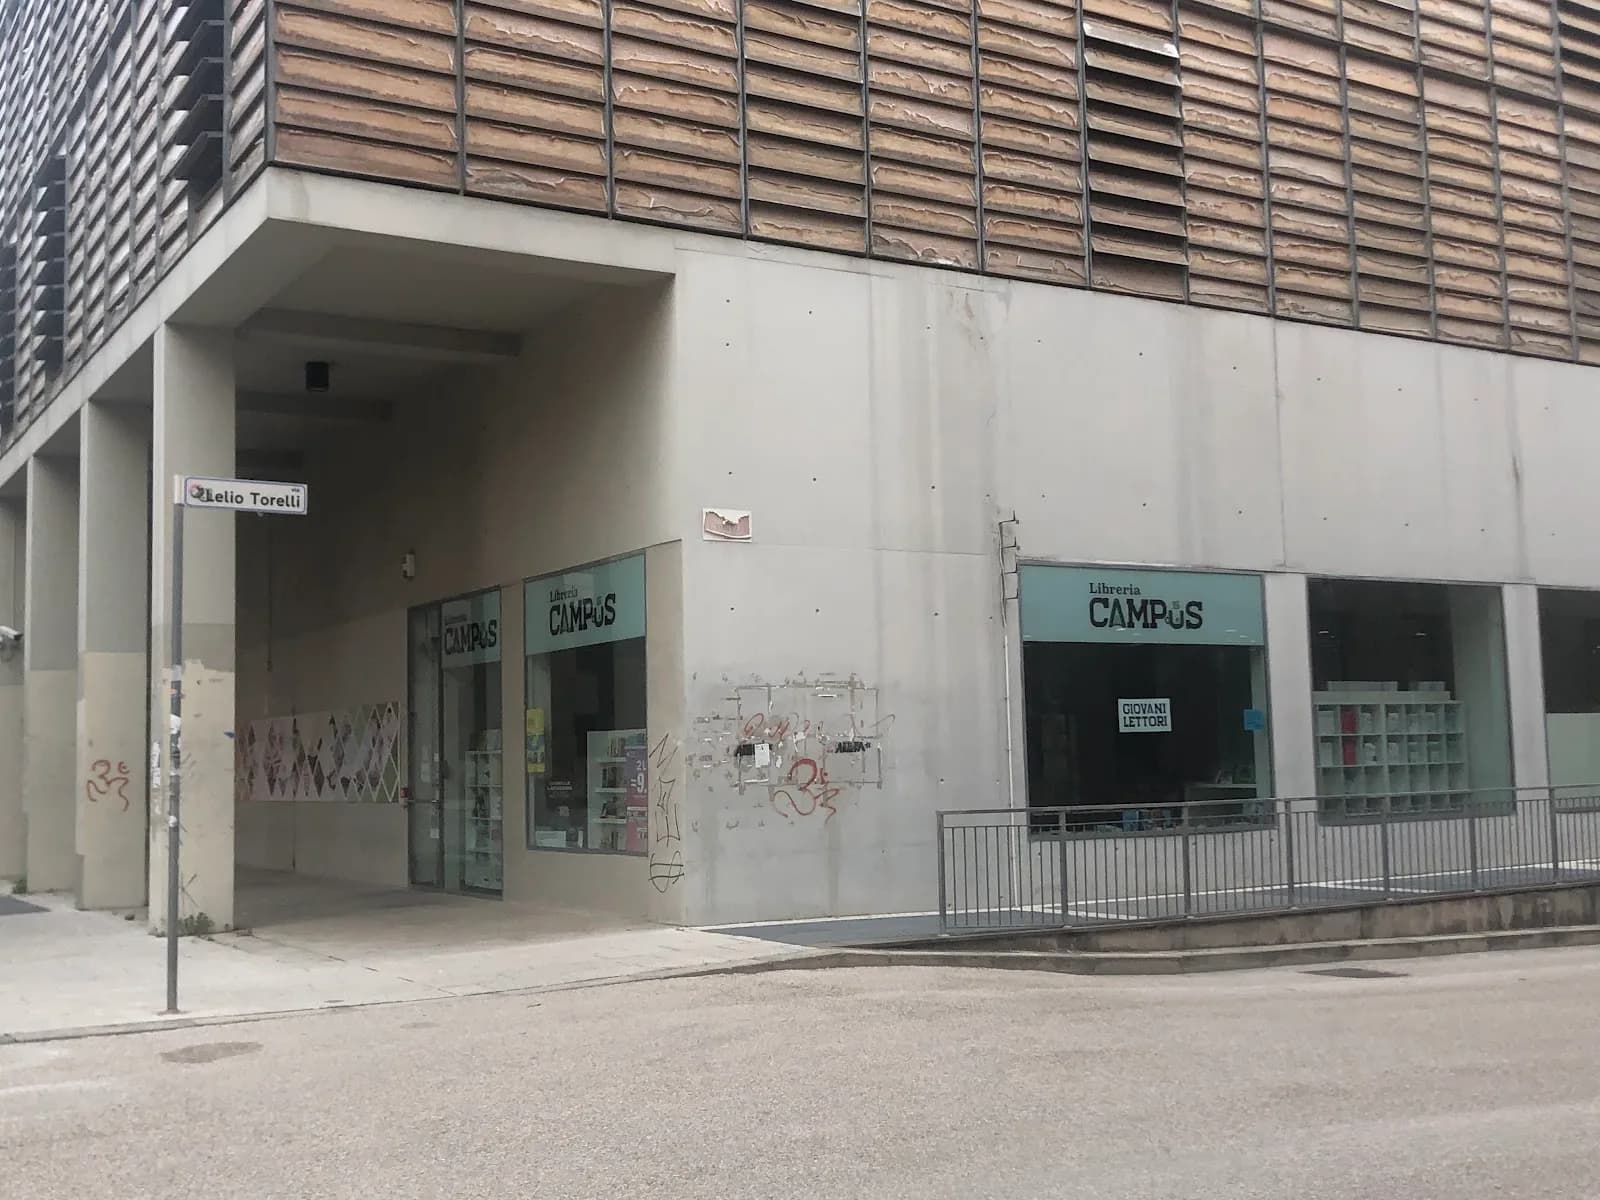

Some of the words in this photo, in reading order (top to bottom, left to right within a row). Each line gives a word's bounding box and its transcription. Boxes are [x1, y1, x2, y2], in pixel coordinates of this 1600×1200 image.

[206, 488, 245, 505] Lelio
[249, 492, 301, 508] Torelli
[549, 584, 579, 603] Libreria
[1088, 582, 1142, 596] Libreria
[550, 592, 616, 637] CAMPUS
[1089, 597, 1203, 630] CAMPUS
[444, 619, 498, 656] CAMPUS
[1122, 703, 1167, 715] GIOVANI
[1123, 715, 1168, 728] LETTORI
